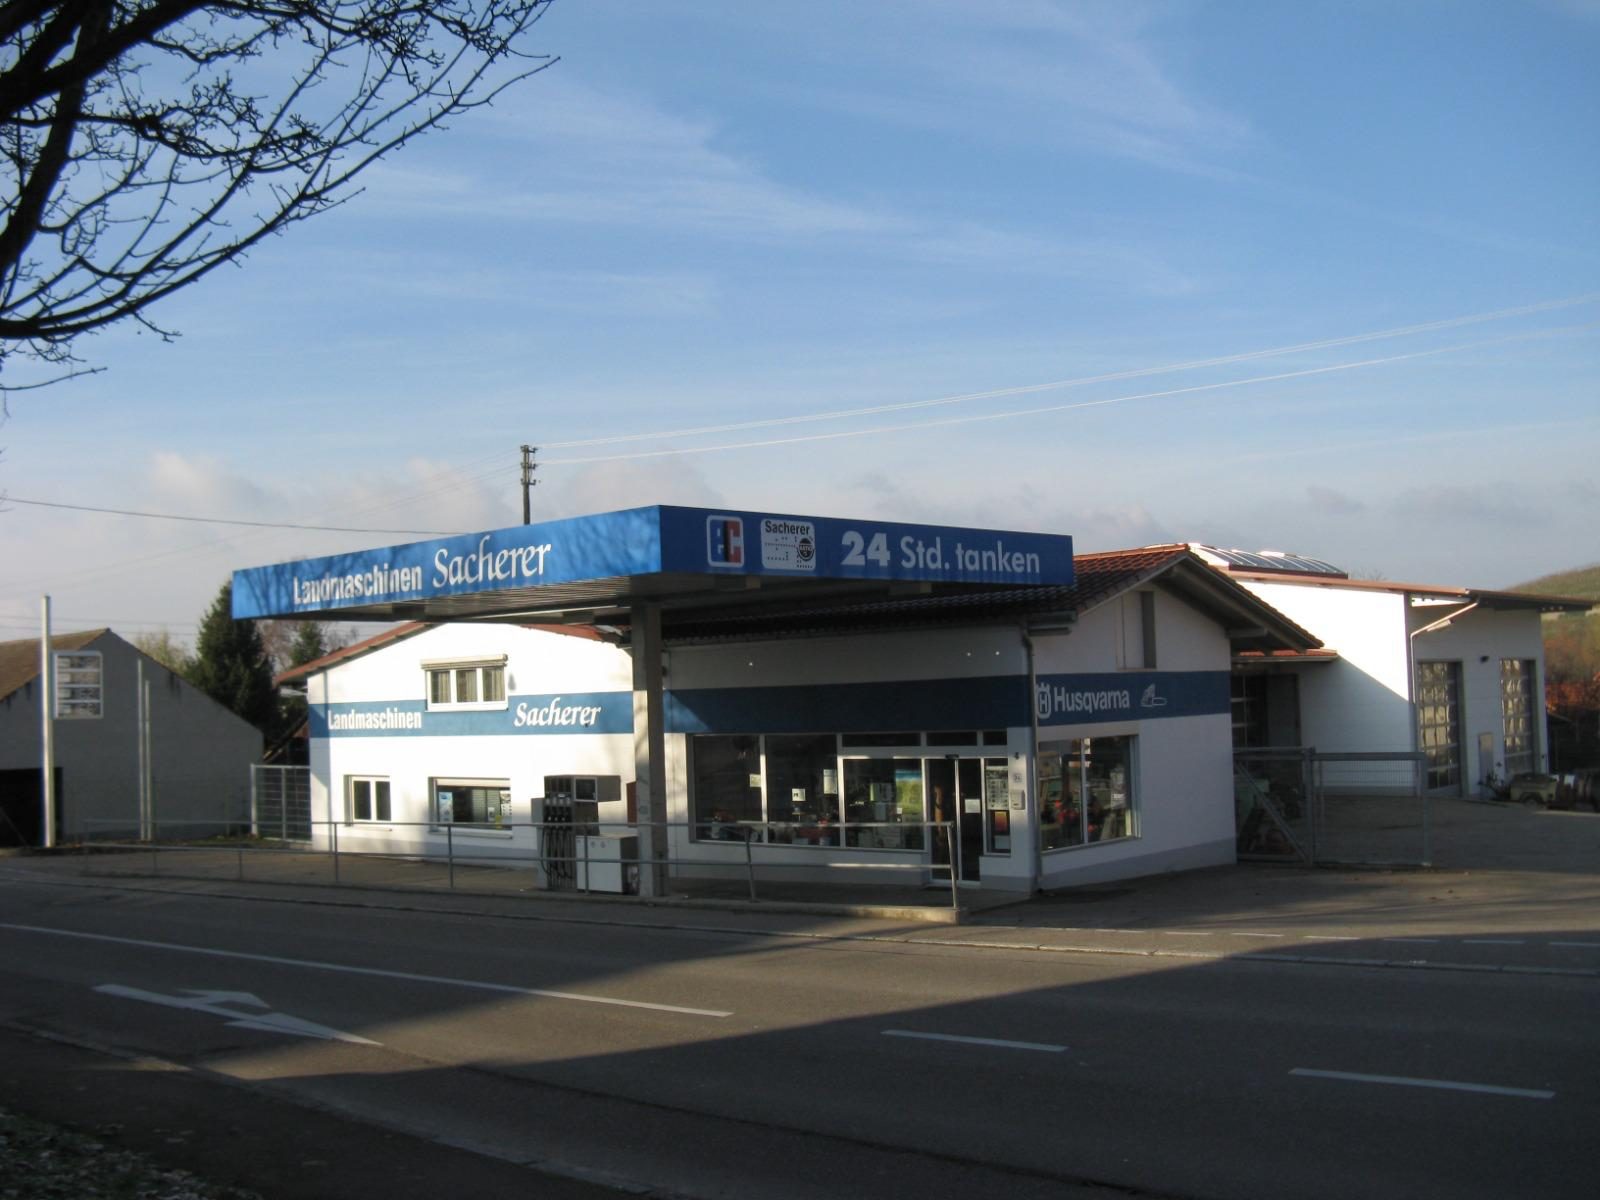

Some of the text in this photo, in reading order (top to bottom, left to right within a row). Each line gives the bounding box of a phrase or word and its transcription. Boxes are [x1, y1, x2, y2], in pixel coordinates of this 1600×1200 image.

[764, 520, 810, 535] Sacherer
[841, 530, 1040, 575] 24 Std. tanken
[293, 534, 552, 605] Landmaschinen Sacherer
[327, 697, 603, 730] Landmaschinen Sacherer
[1053, 686, 1131, 714] Husqvarna
